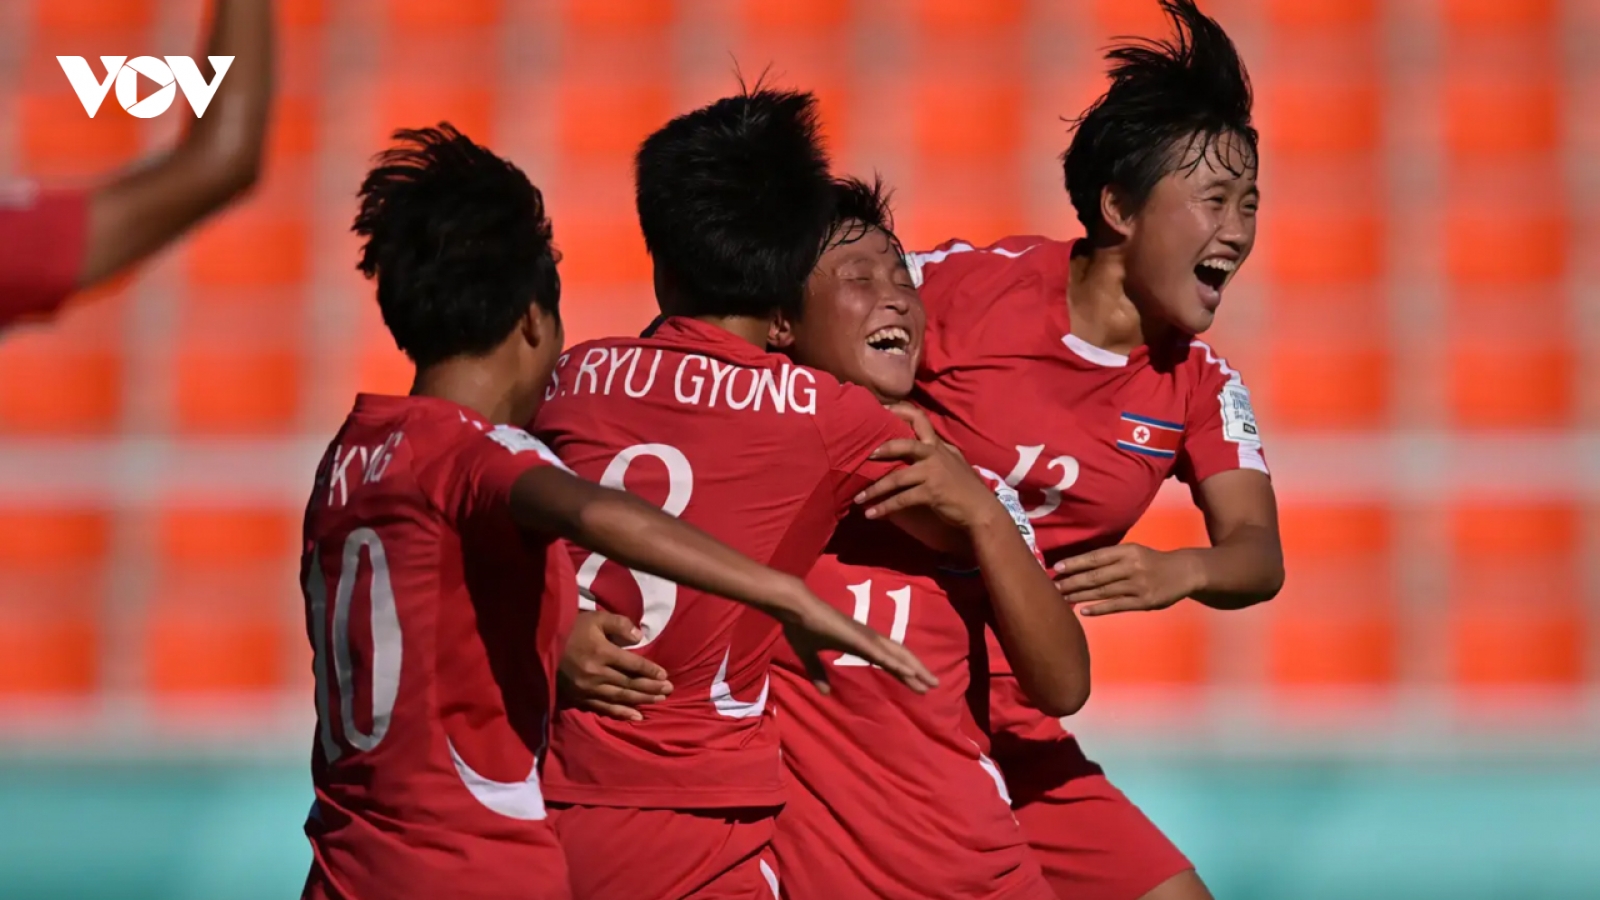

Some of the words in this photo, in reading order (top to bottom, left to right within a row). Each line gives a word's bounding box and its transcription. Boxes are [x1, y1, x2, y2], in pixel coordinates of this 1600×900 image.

[573, 346, 662, 398] RYU
[674, 354, 817, 416] GYONG
[1004, 443, 1080, 519] 13
[576, 443, 694, 650] 8
[306, 527, 404, 765] 10
[833, 578, 912, 669] 11
